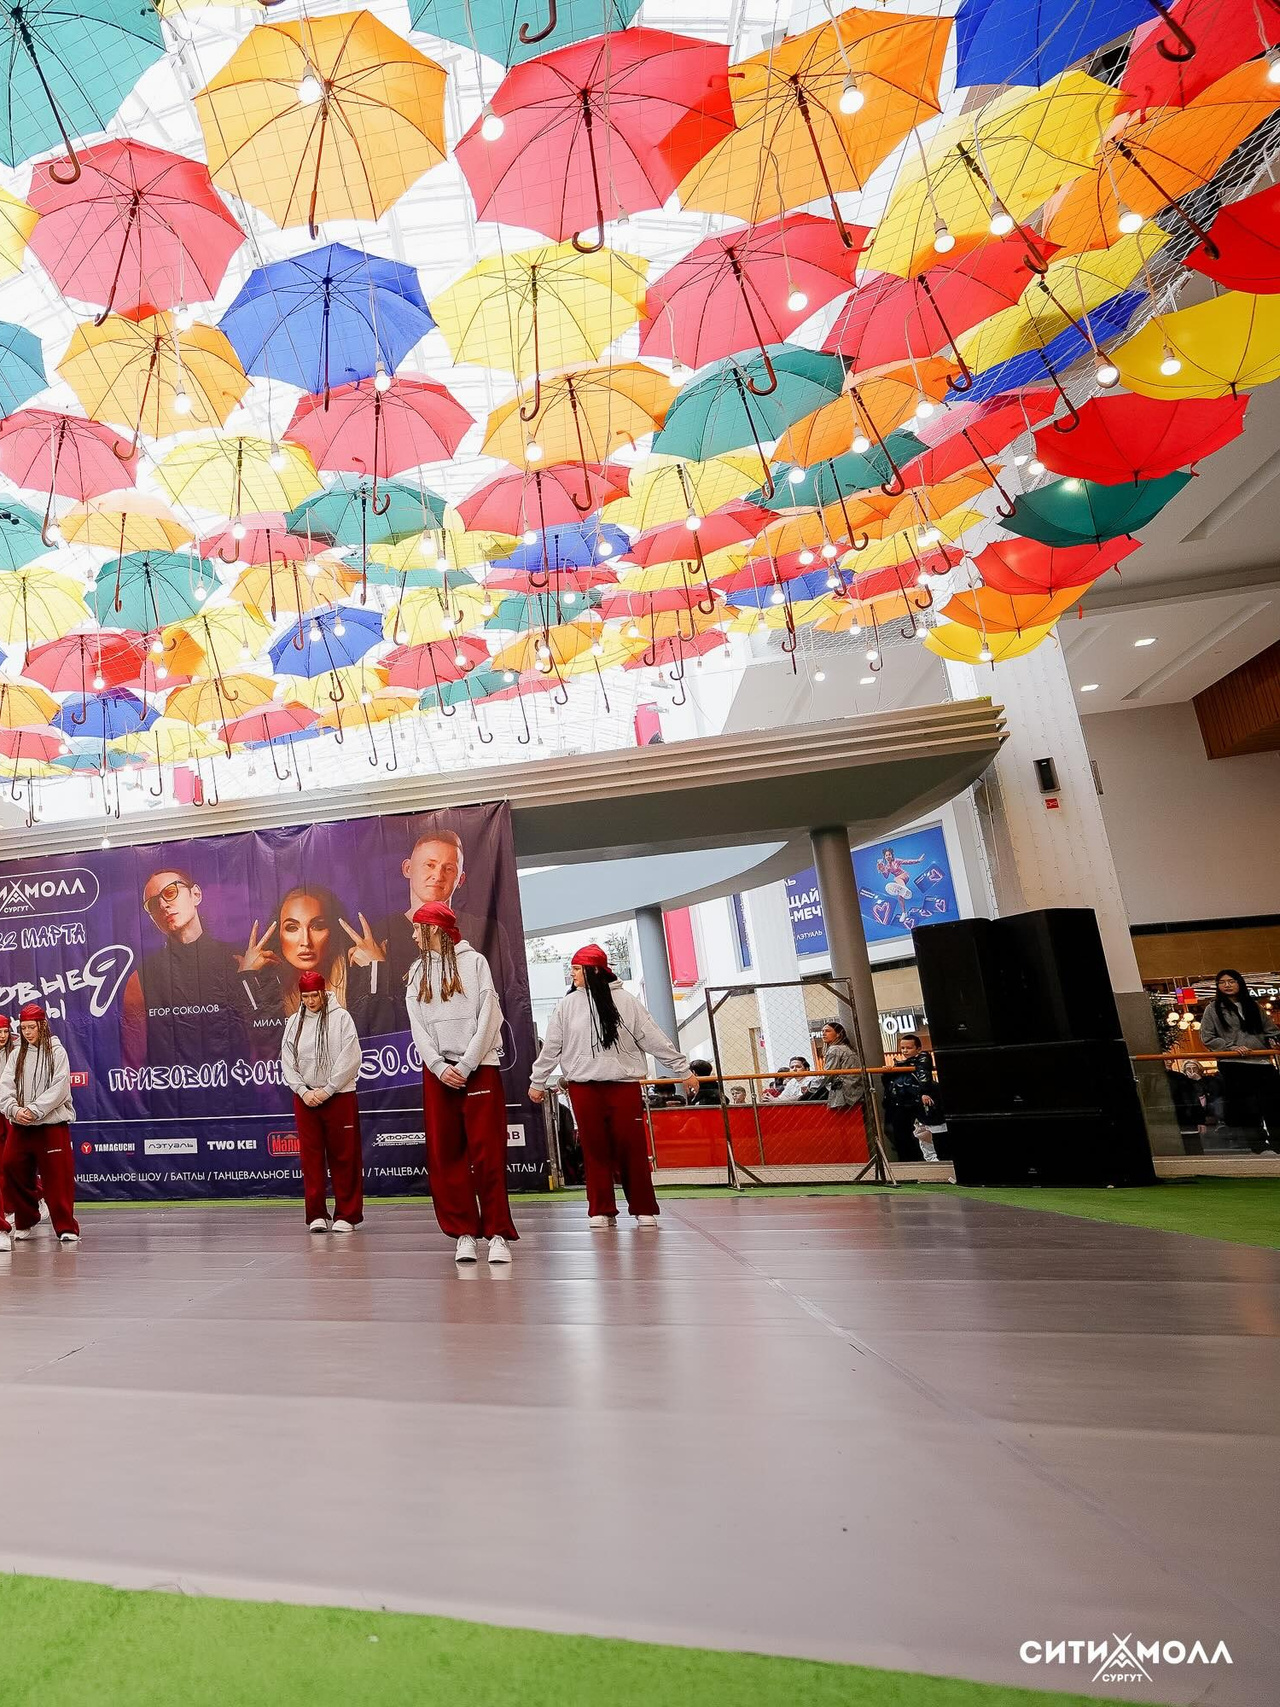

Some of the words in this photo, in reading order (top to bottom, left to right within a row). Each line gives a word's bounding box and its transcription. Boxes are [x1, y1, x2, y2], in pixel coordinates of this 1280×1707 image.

[24, 878, 86, 899] МОЛЛ
[3, 905, 30, 914] СУРГУТ
[21, 922, 86, 949] МАРТА
[148, 1007, 171, 1017] ЕГОР
[172, 1004, 220, 1016] СОКОЛОВ
[253, 1018, 282, 1028] МИЛА
[108, 1060, 228, 1092] ПРИЗОВОЙ
[230, 1058, 291, 1087] ФОН
[94, 1143, 136, 1152] YAMAGUCHI
[206, 1140, 233, 1150] TWO
[237, 1139, 257, 1149] KEI
[373, 1166, 429, 1177] ТАНЦЕВАЛ
[506, 1162, 537, 1173] АТТЛЫ
[74, 1171, 137, 1183] НЦЕВАЛЬНОЕ
[138, 1172, 162, 1182] ШОУ
[170, 1171, 205, 1181] БАТТЛЫ
[213, 1169, 290, 1181] ТАНЦЕВАЛЬНОЕ
